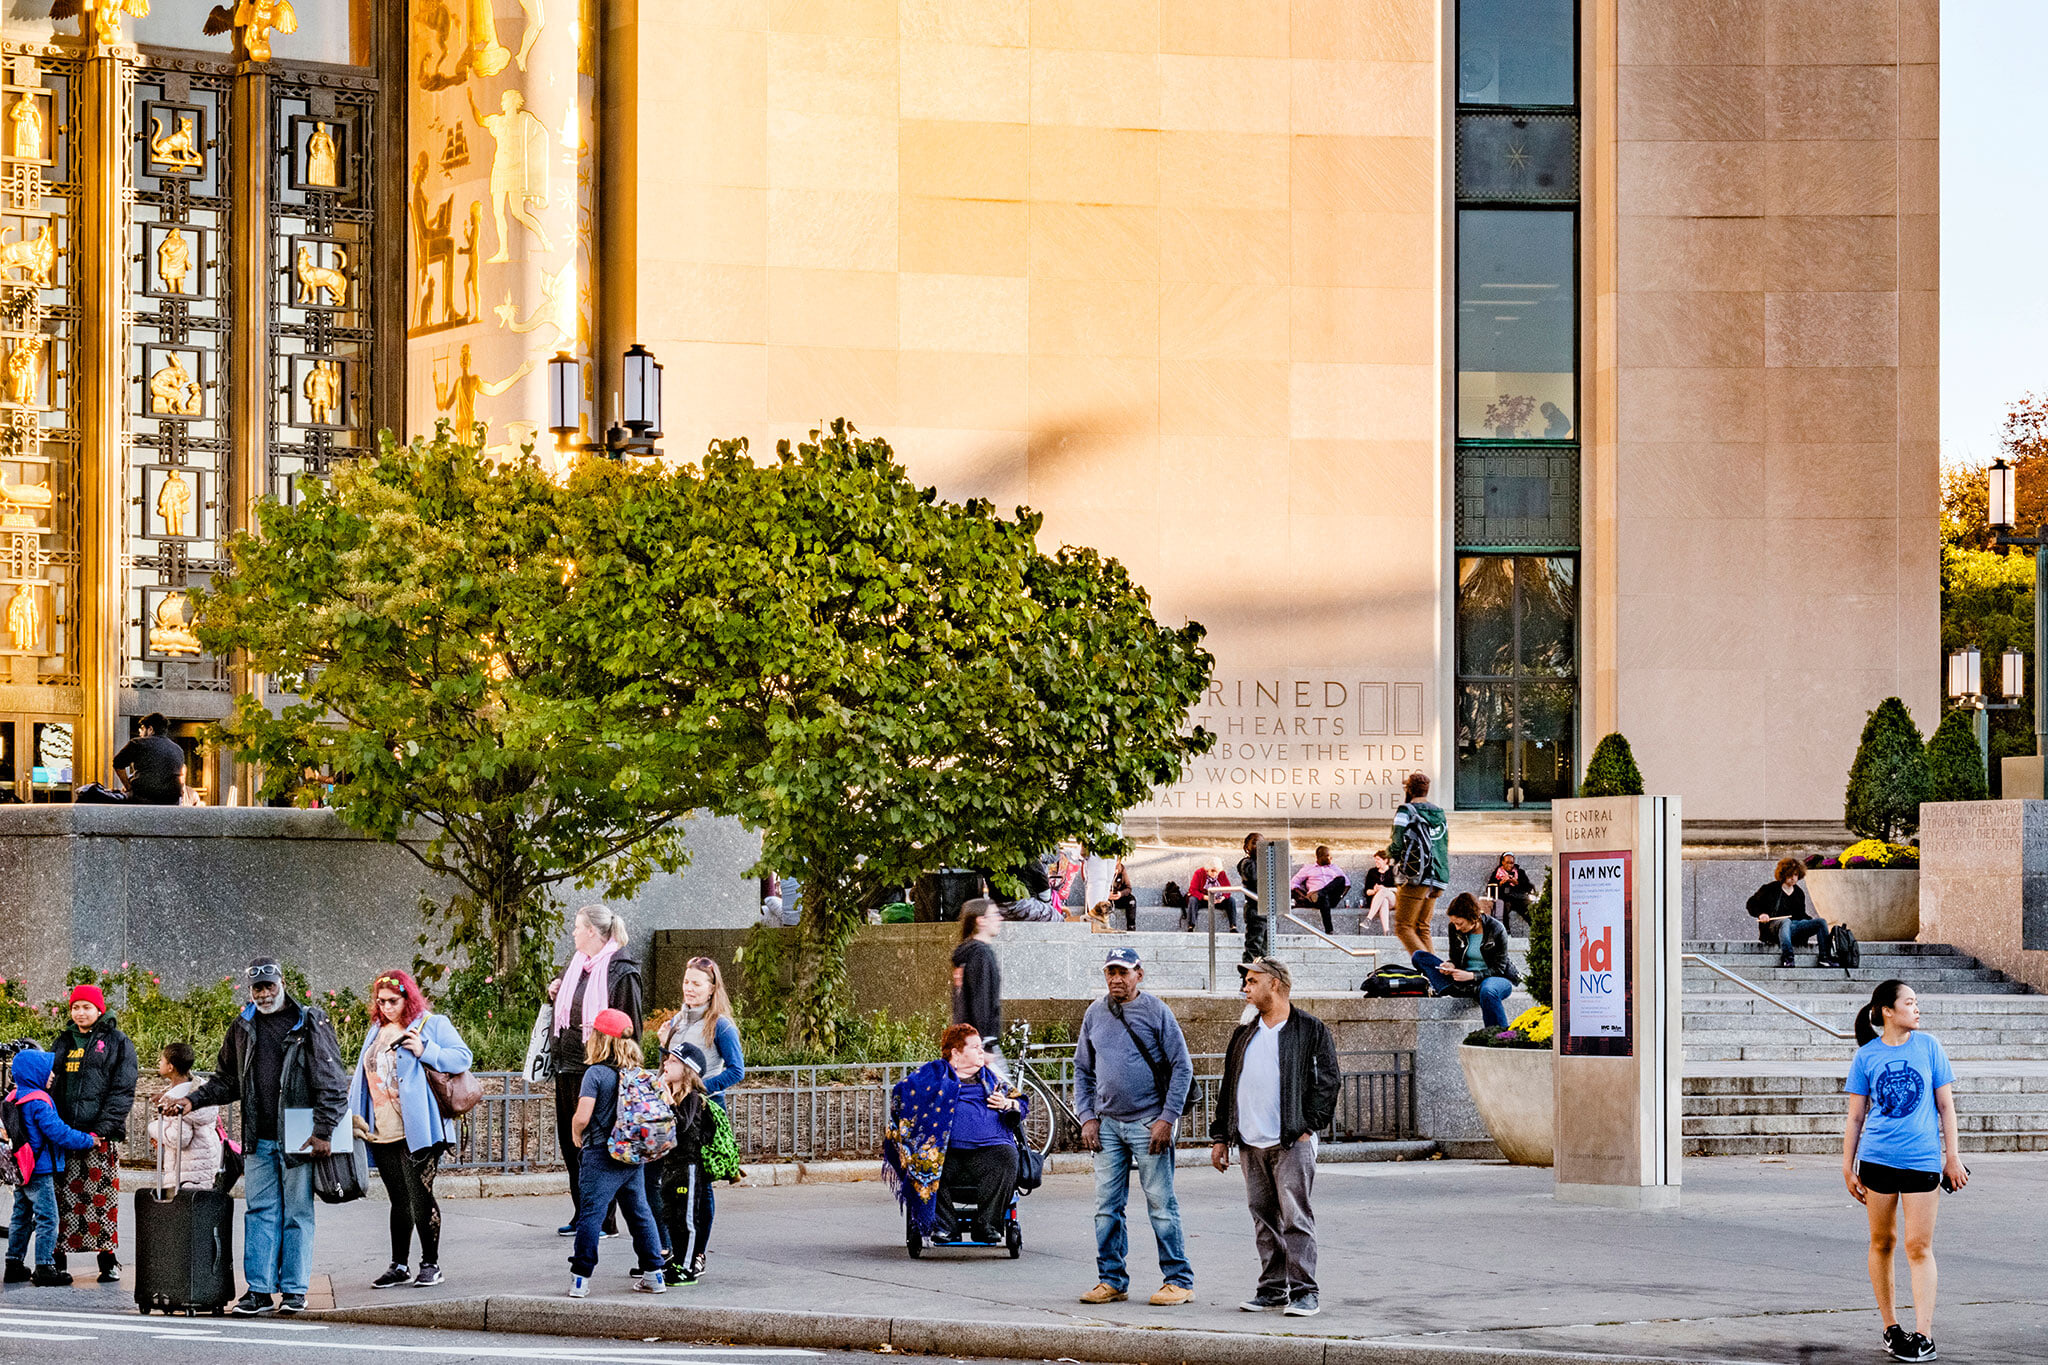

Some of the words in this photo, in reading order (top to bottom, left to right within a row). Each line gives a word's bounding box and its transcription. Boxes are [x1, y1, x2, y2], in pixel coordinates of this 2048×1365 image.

[1208, 679, 1347, 708] RINED
[1228, 716, 1344, 736] HEARTS
[1203, 743, 1288, 760] ABOVE
[1301, 744, 1349, 761] THE
[1363, 744, 1424, 761] TIDE
[1205, 767, 1320, 785] WONDER
[1334, 767, 1424, 786] START
[1196, 792, 1243, 809] HAS
[1253, 792, 1342, 809] NEVER
[1359, 793, 1401, 810] DIE
[1565, 809, 1613, 823] CENTRAL
[1565, 826, 1608, 840] LIBRARY
[1995, 839, 2020, 850] DUTY
[1571, 867, 1575, 880] I
[1578, 866, 1595, 880] AM
[1598, 865, 1621, 879] NYC
[1580, 973, 1612, 994] NYC
